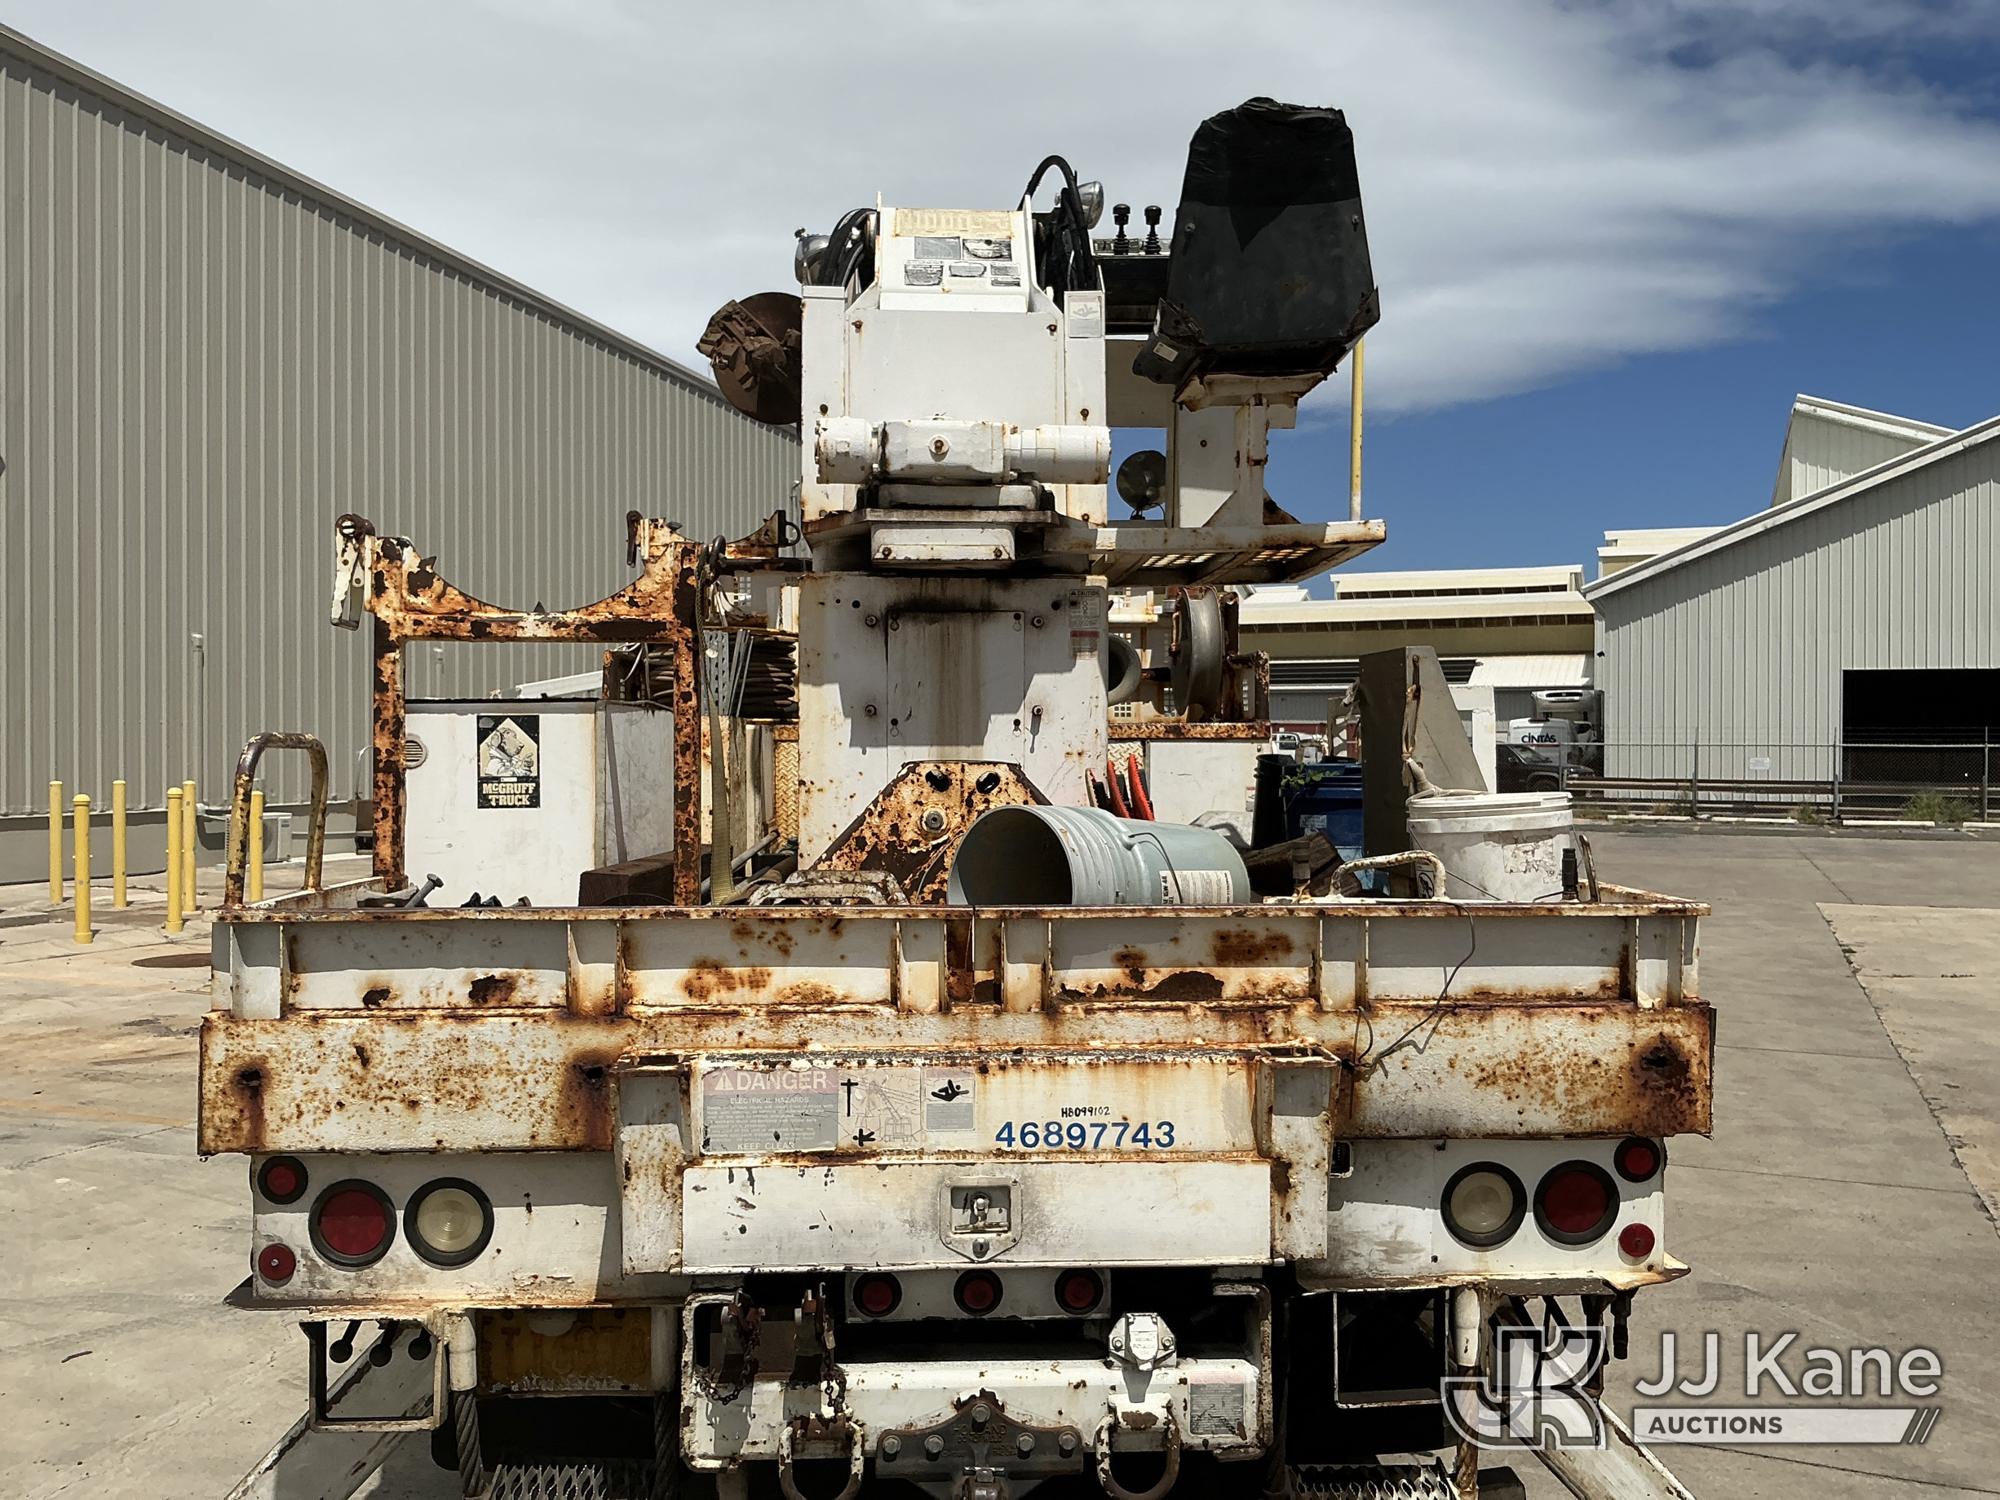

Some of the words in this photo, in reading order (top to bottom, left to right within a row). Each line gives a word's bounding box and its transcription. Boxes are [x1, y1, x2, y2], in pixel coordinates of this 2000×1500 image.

[488, 794, 530, 807] TRUCK
[736, 1071, 828, 1090] DANGER
[995, 1120, 1175, 1149] 46897743
[737, 1142, 760, 1150] KEEP
[765, 1141, 796, 1150] CLEAR
